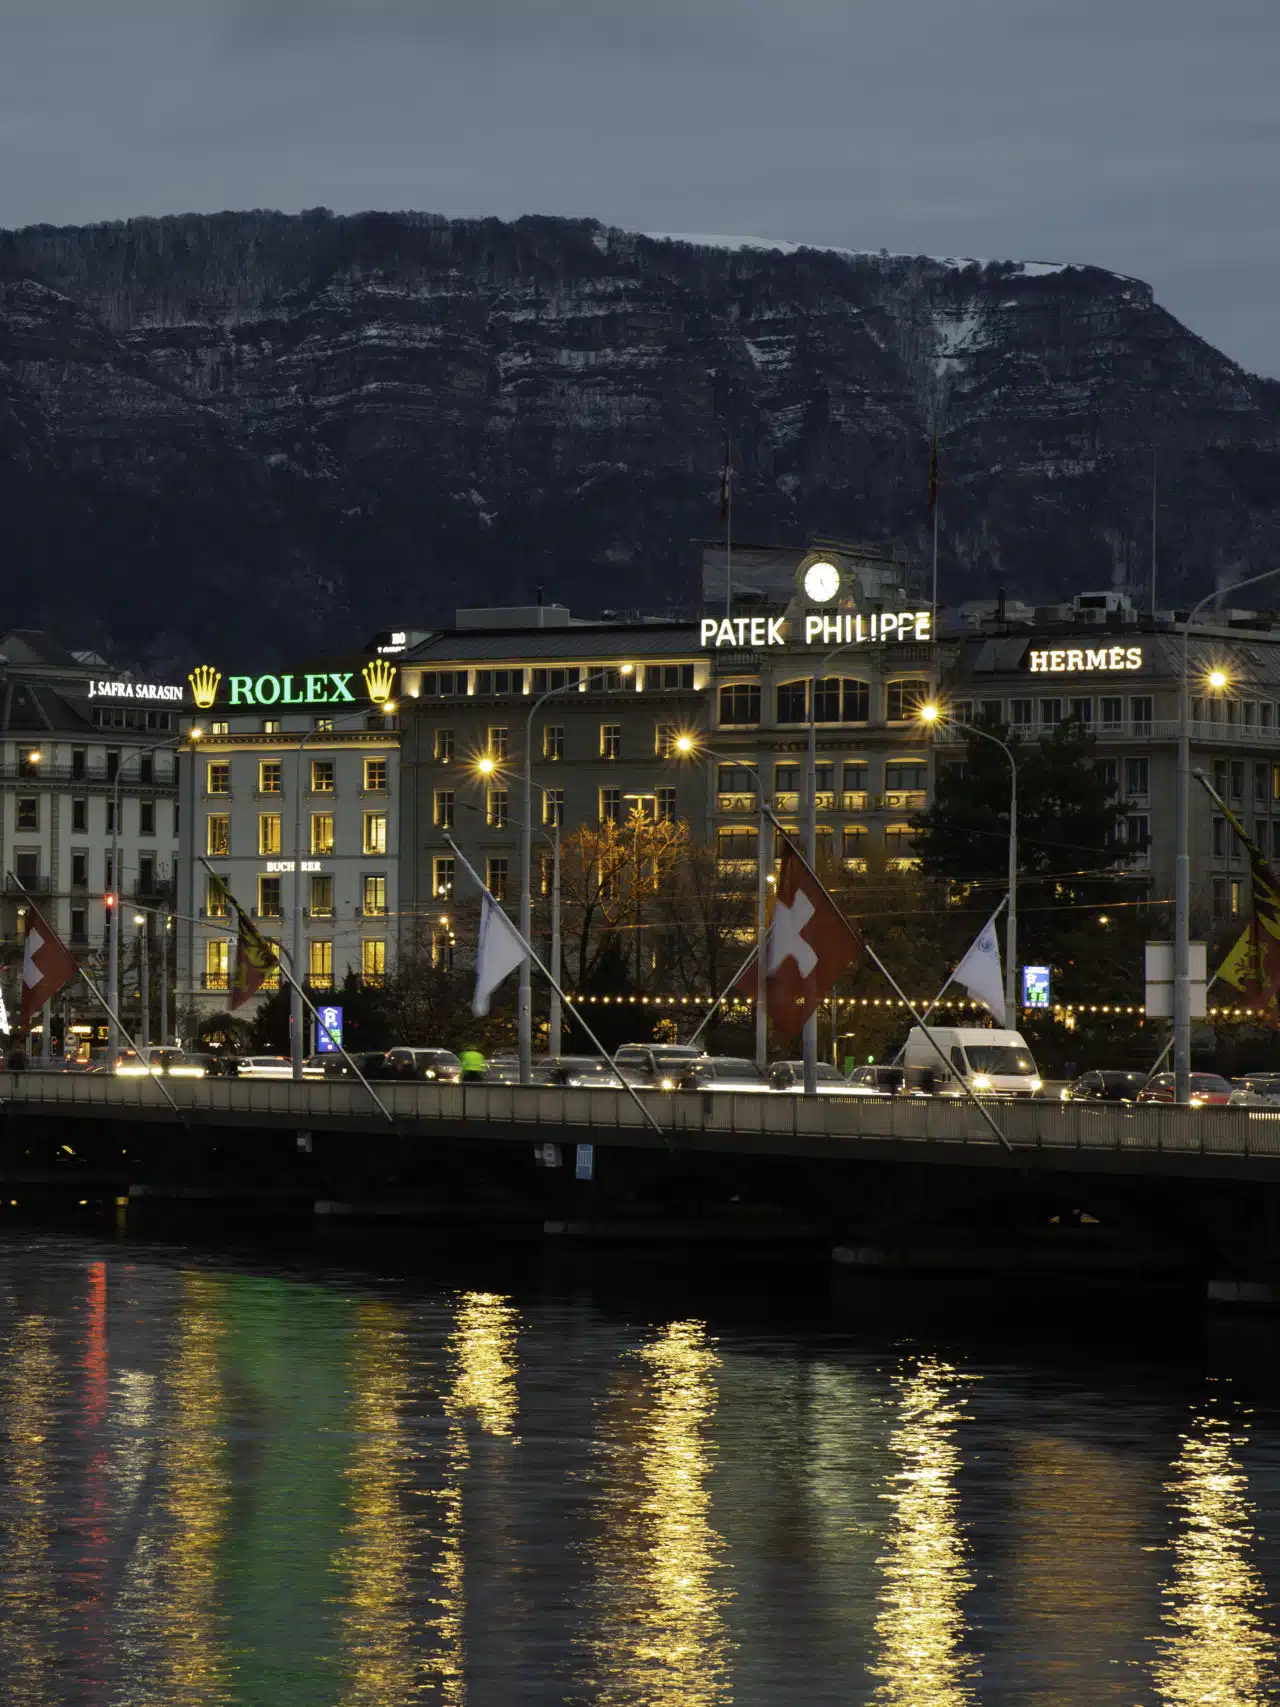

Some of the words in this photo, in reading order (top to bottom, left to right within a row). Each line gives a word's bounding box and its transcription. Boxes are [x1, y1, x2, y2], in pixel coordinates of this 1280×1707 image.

[700, 617, 785, 647] PATEK
[805, 611, 931, 645] PHILIPPE
[88, 680, 97, 698] J.
[98, 681, 133, 697] SAFRA
[136, 684, 183, 700] SARASIN
[228, 672, 356, 705] ROLEX
[267, 861, 321, 872] BUCHRER
